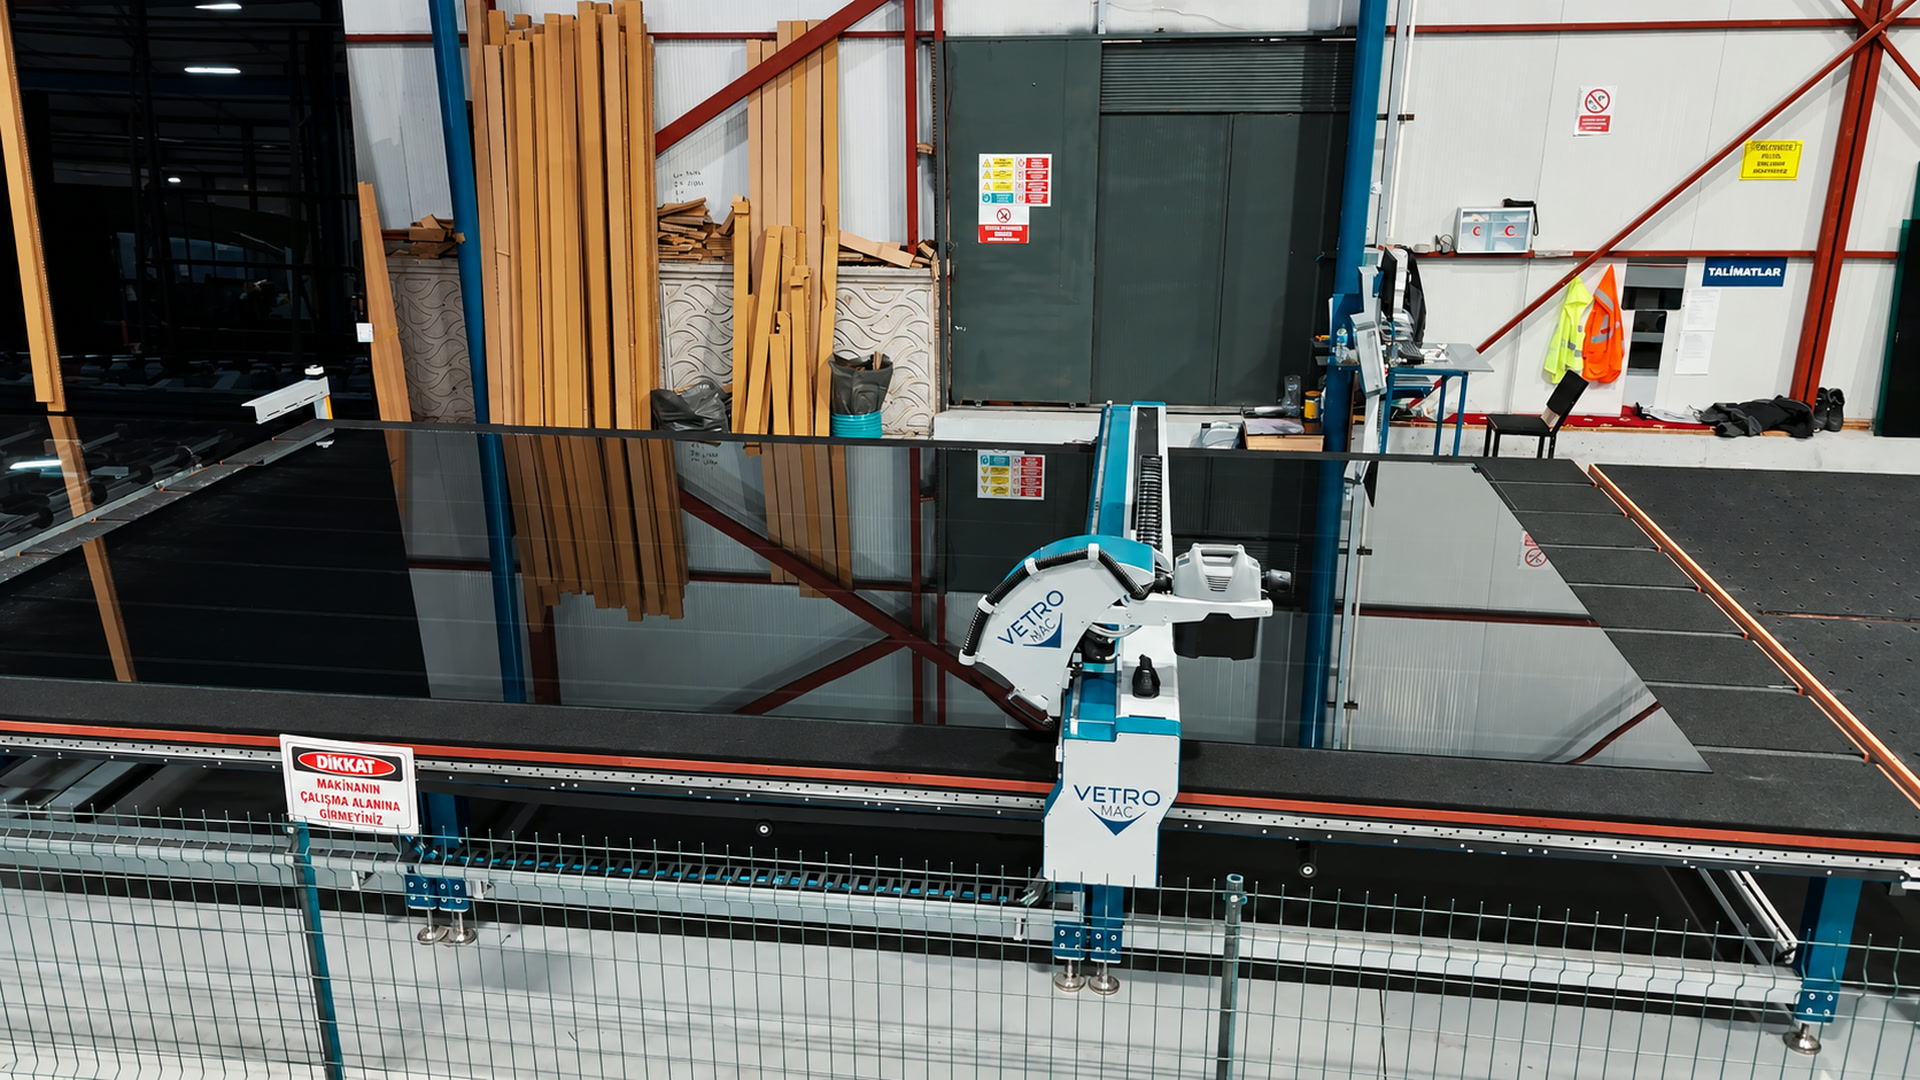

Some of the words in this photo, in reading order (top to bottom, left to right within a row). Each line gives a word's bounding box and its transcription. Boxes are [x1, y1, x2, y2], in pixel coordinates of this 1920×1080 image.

[1708, 265, 1781, 277] TALİMATLAR
[997, 590, 1064, 644] VETRO
[1030, 617, 1056, 643] MAC
[316, 754, 375, 774] DİKKAT
[316, 778, 380, 795] MAKİNANIN
[1073, 784, 1161, 806] VETRO
[300, 790, 349, 807] ÇALIŞMA
[352, 797, 401, 812] ALANINA
[319, 807, 383, 826] GİRMEYİNİZ
[1101, 805, 1133, 818] MAC
